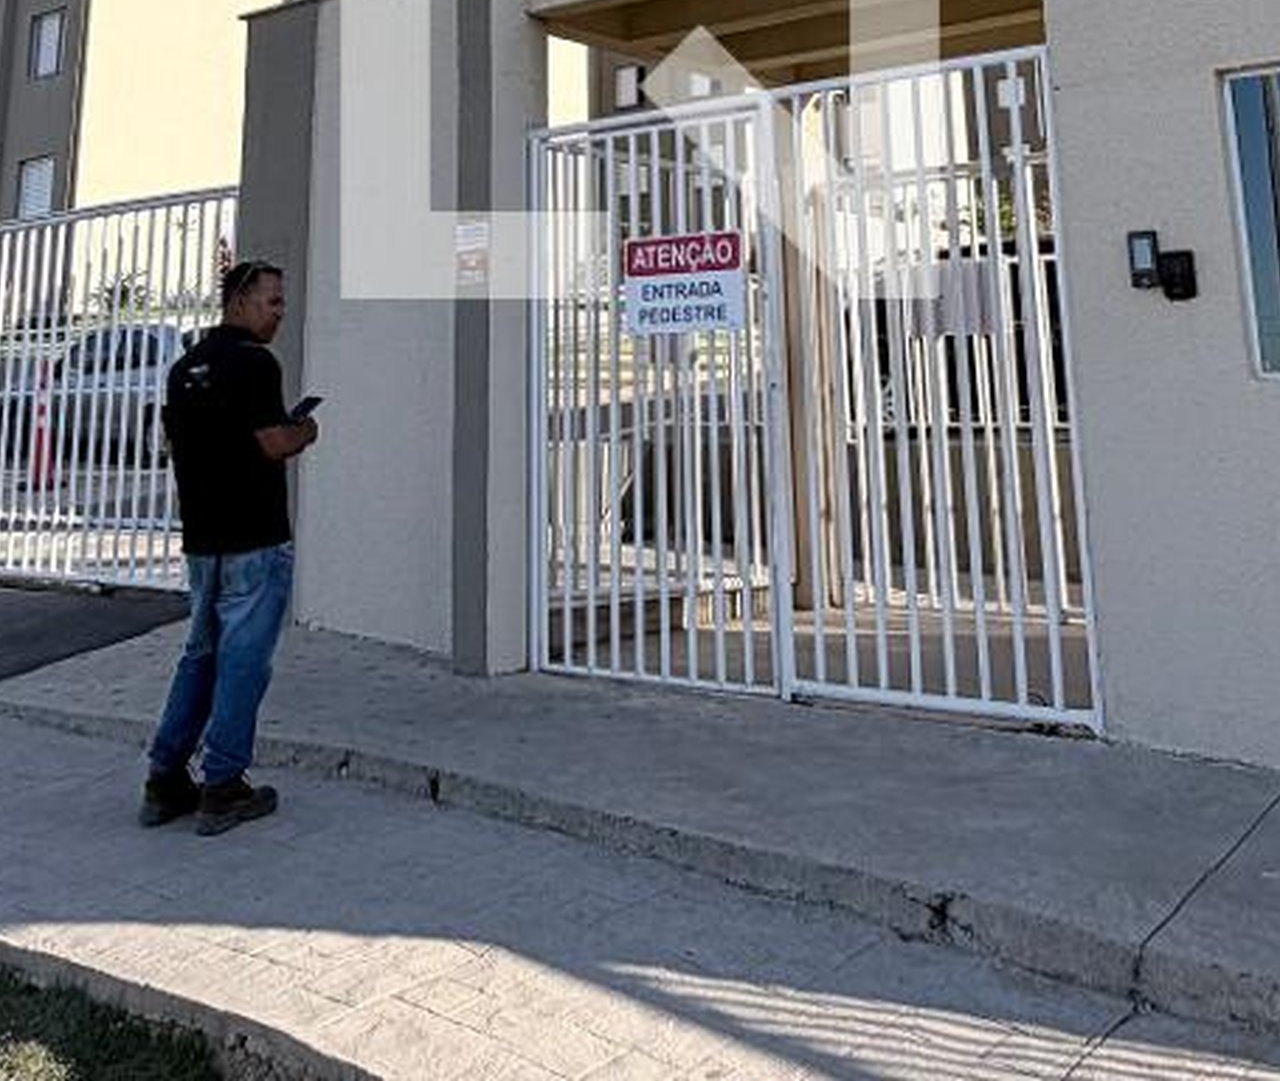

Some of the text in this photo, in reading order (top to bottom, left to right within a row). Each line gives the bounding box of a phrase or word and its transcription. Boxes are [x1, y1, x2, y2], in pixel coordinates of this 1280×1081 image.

[631, 235, 733, 271] ATENÇÃO
[641, 281, 724, 301] ENTRADA
[638, 304, 727, 325] PEDESTRE
